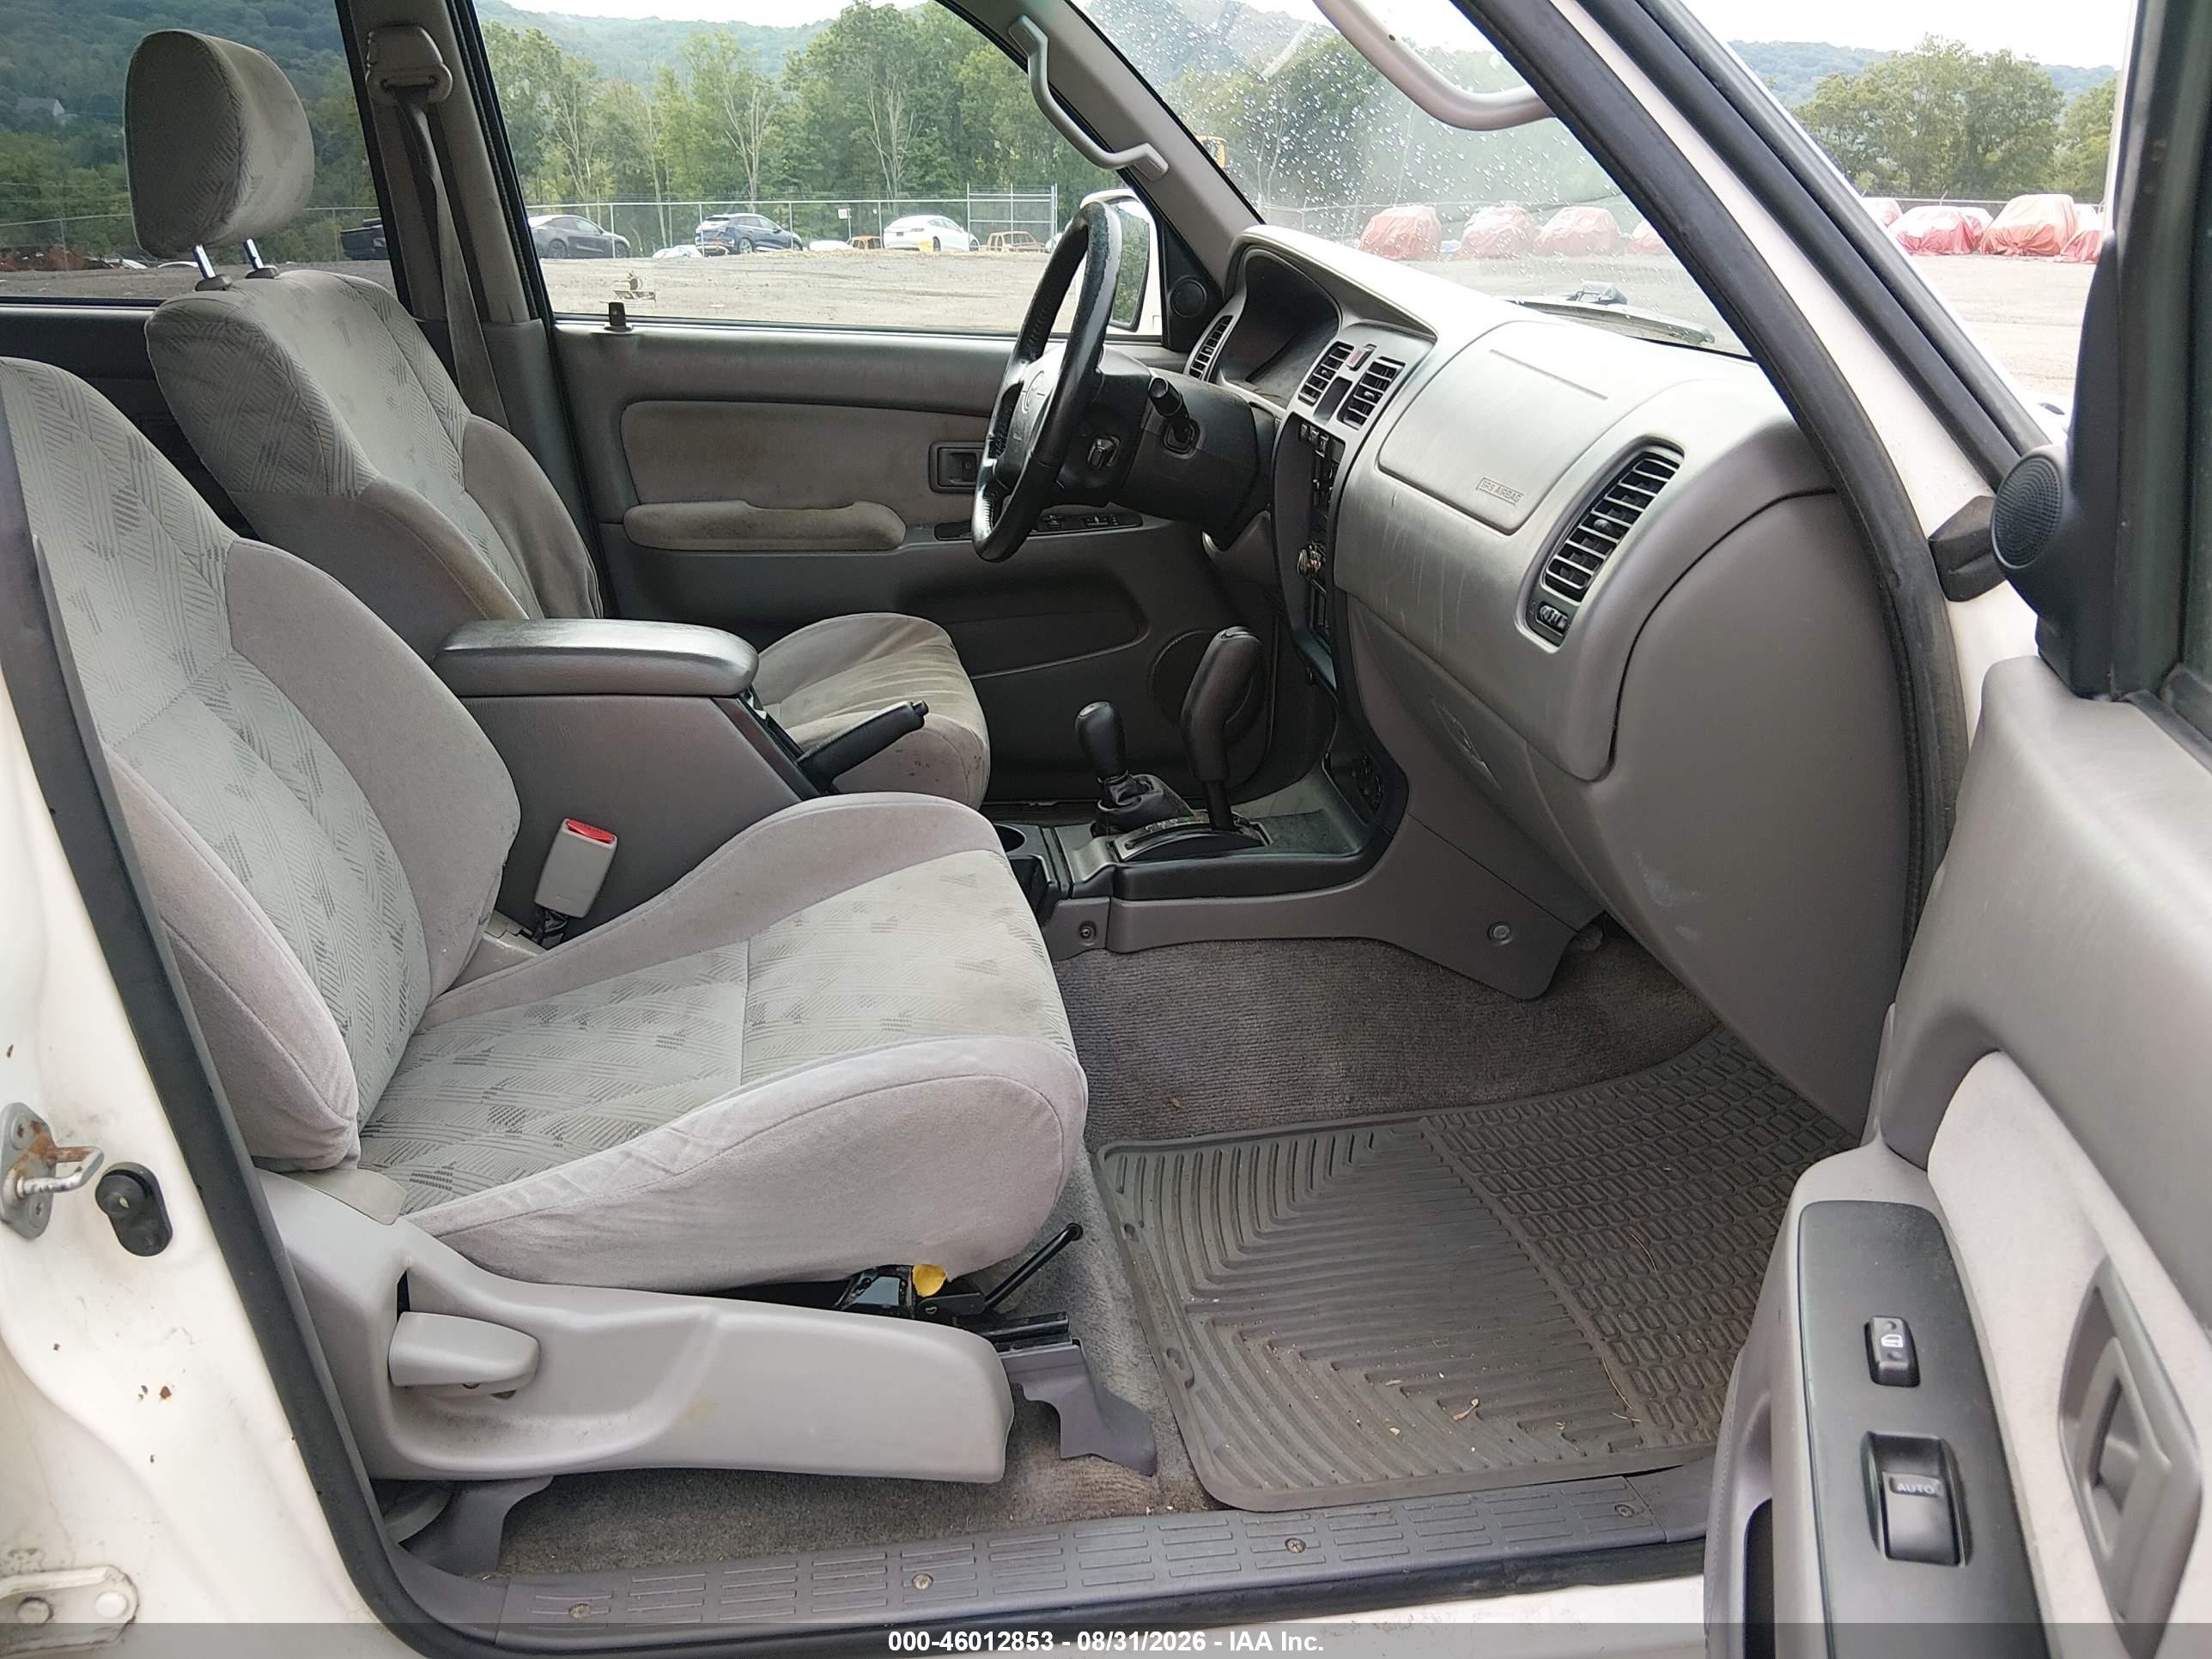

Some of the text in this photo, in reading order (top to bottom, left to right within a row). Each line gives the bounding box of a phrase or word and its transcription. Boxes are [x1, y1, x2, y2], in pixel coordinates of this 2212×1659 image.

[1480, 480, 1522, 503] SRS AIRBAG
[1897, 1482, 1936, 1495] AUTO
